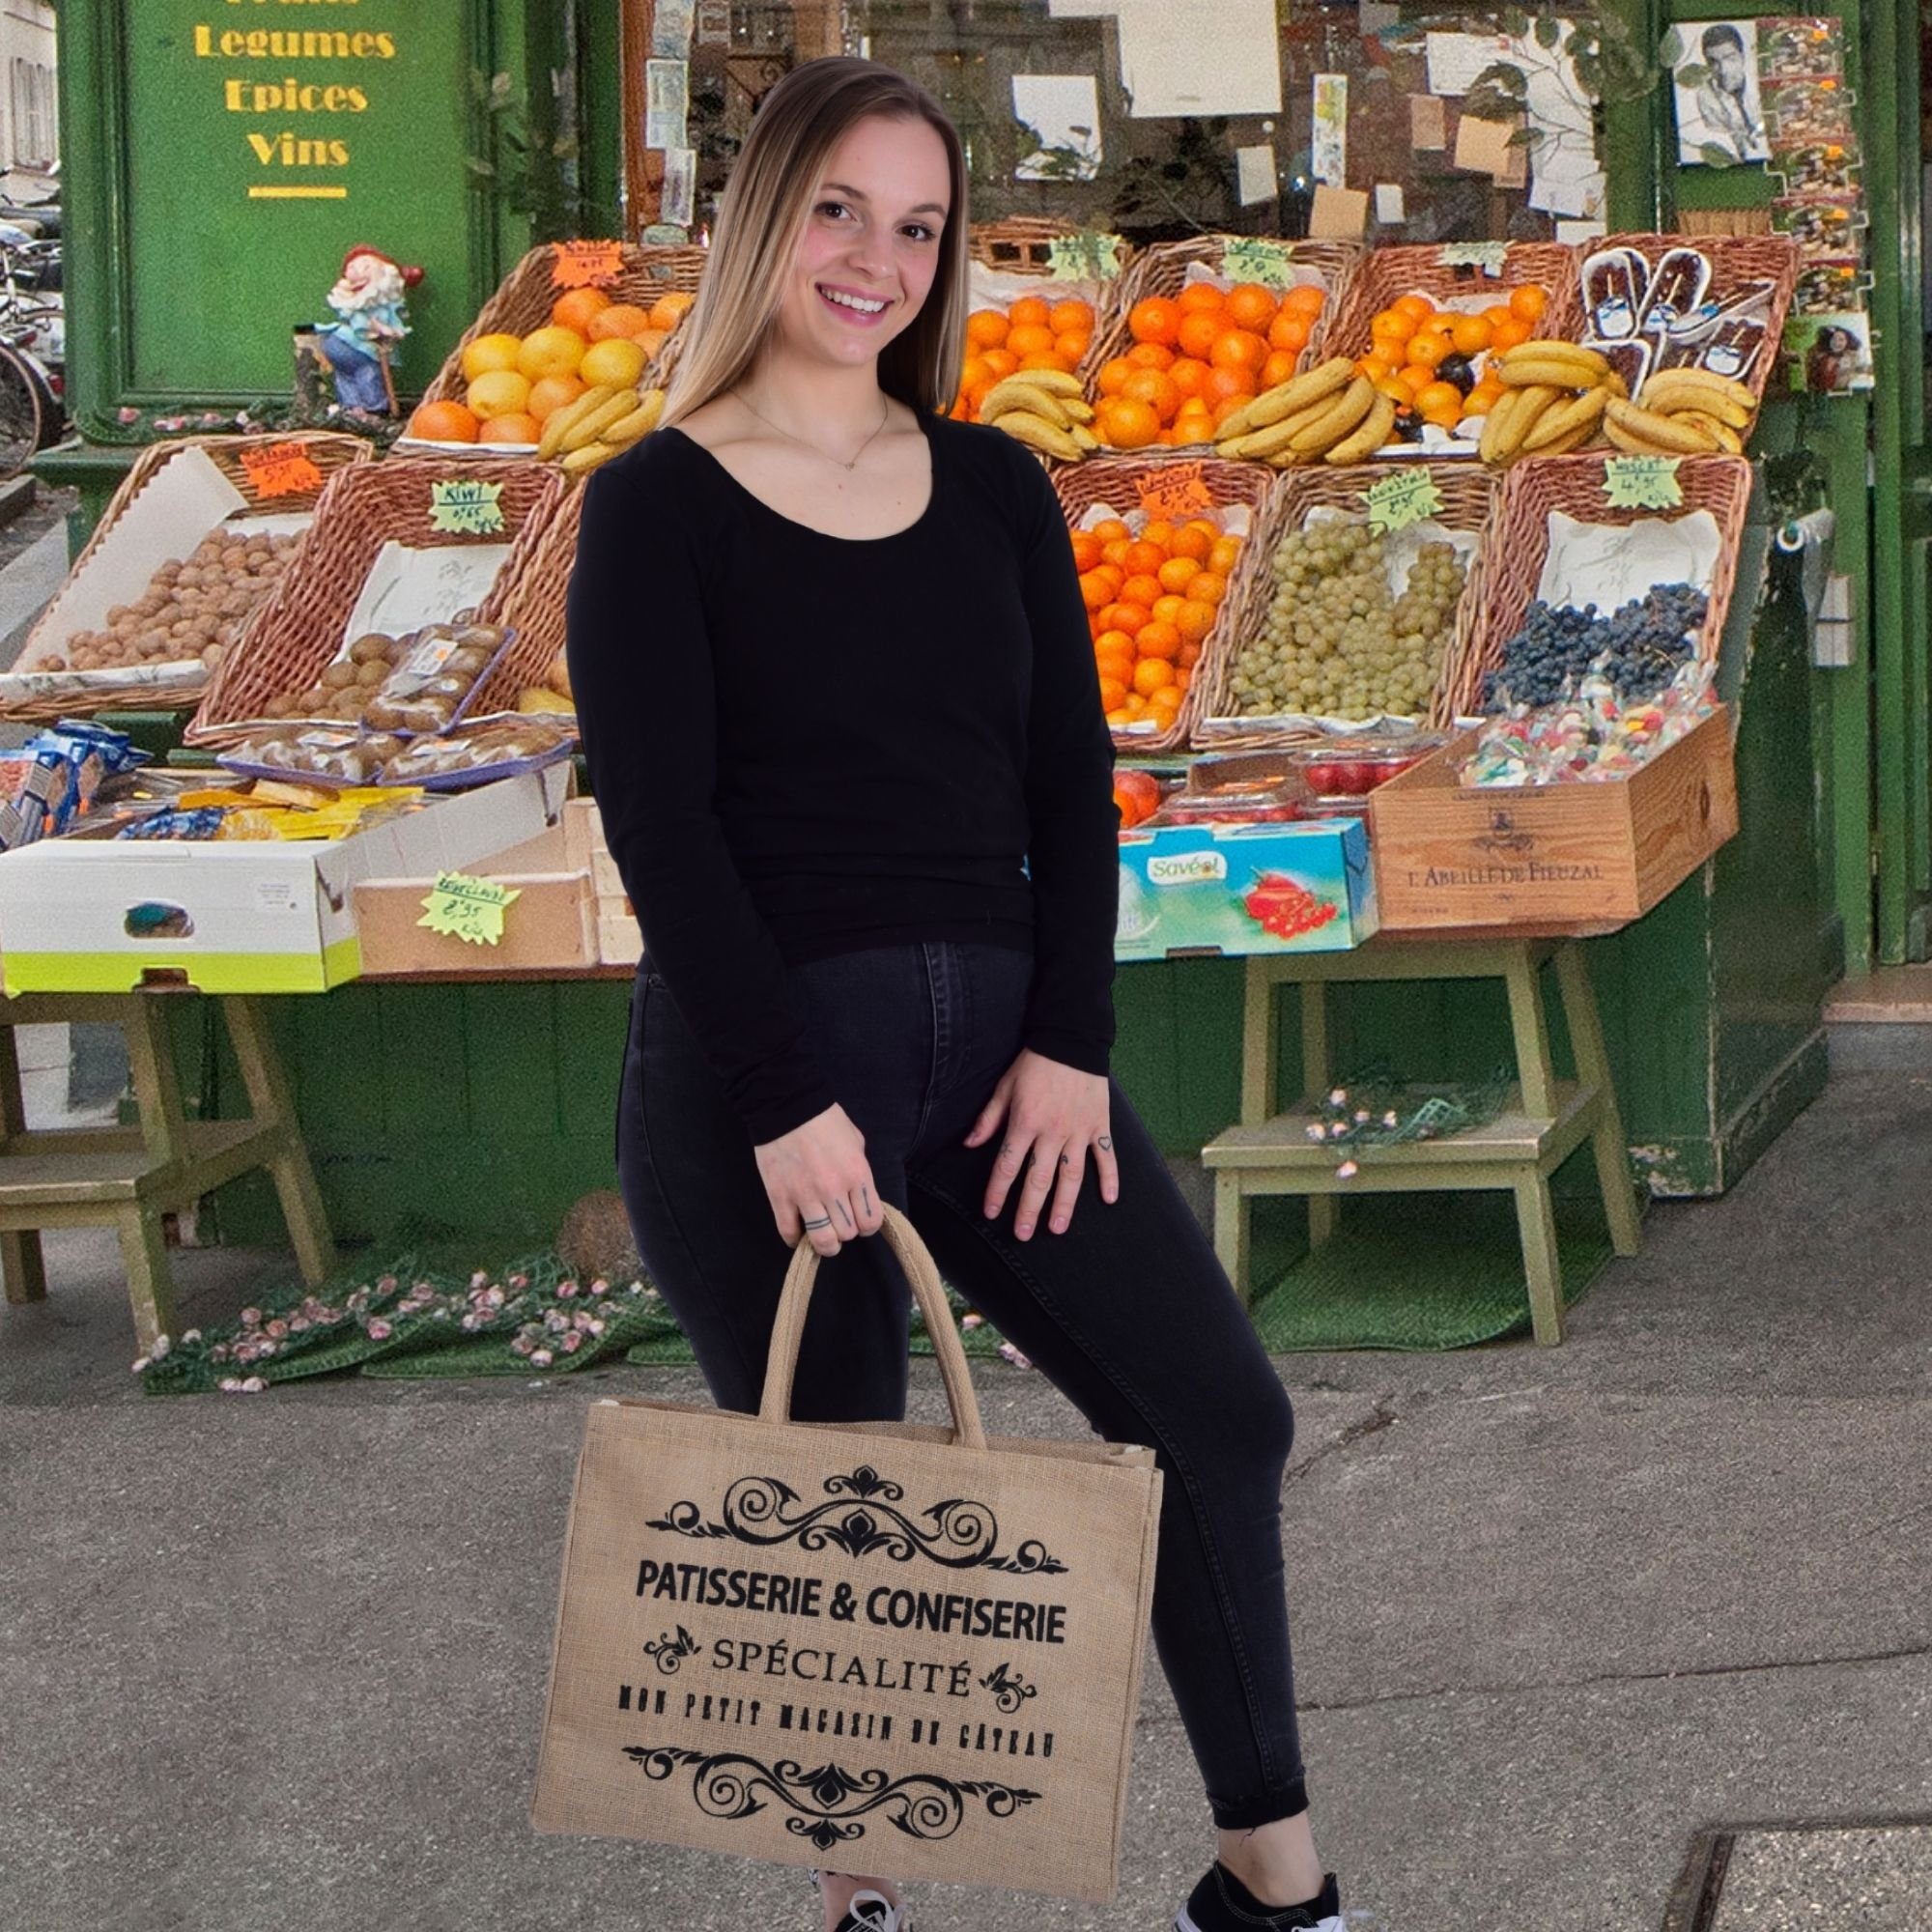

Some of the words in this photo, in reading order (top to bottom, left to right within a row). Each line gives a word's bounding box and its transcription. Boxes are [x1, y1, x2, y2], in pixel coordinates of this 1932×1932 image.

[195, 25, 395, 58] Legumes
[225, 78, 368, 112] Epices
[247, 132, 350, 166] Vins
[445, 485, 482, 502] KIWI
[636, 1559, 822, 1617] PATISSERIE
[829, 1582, 858, 1622] &
[866, 1586, 1067, 1644] CONFISERIE
[712, 1639, 972, 1698] SPÉCIALITÉ
[618, 1684, 667, 1715] MON
[685, 1692, 761, 1726] PETIT
[780, 1703, 893, 1741] MAGASIN
